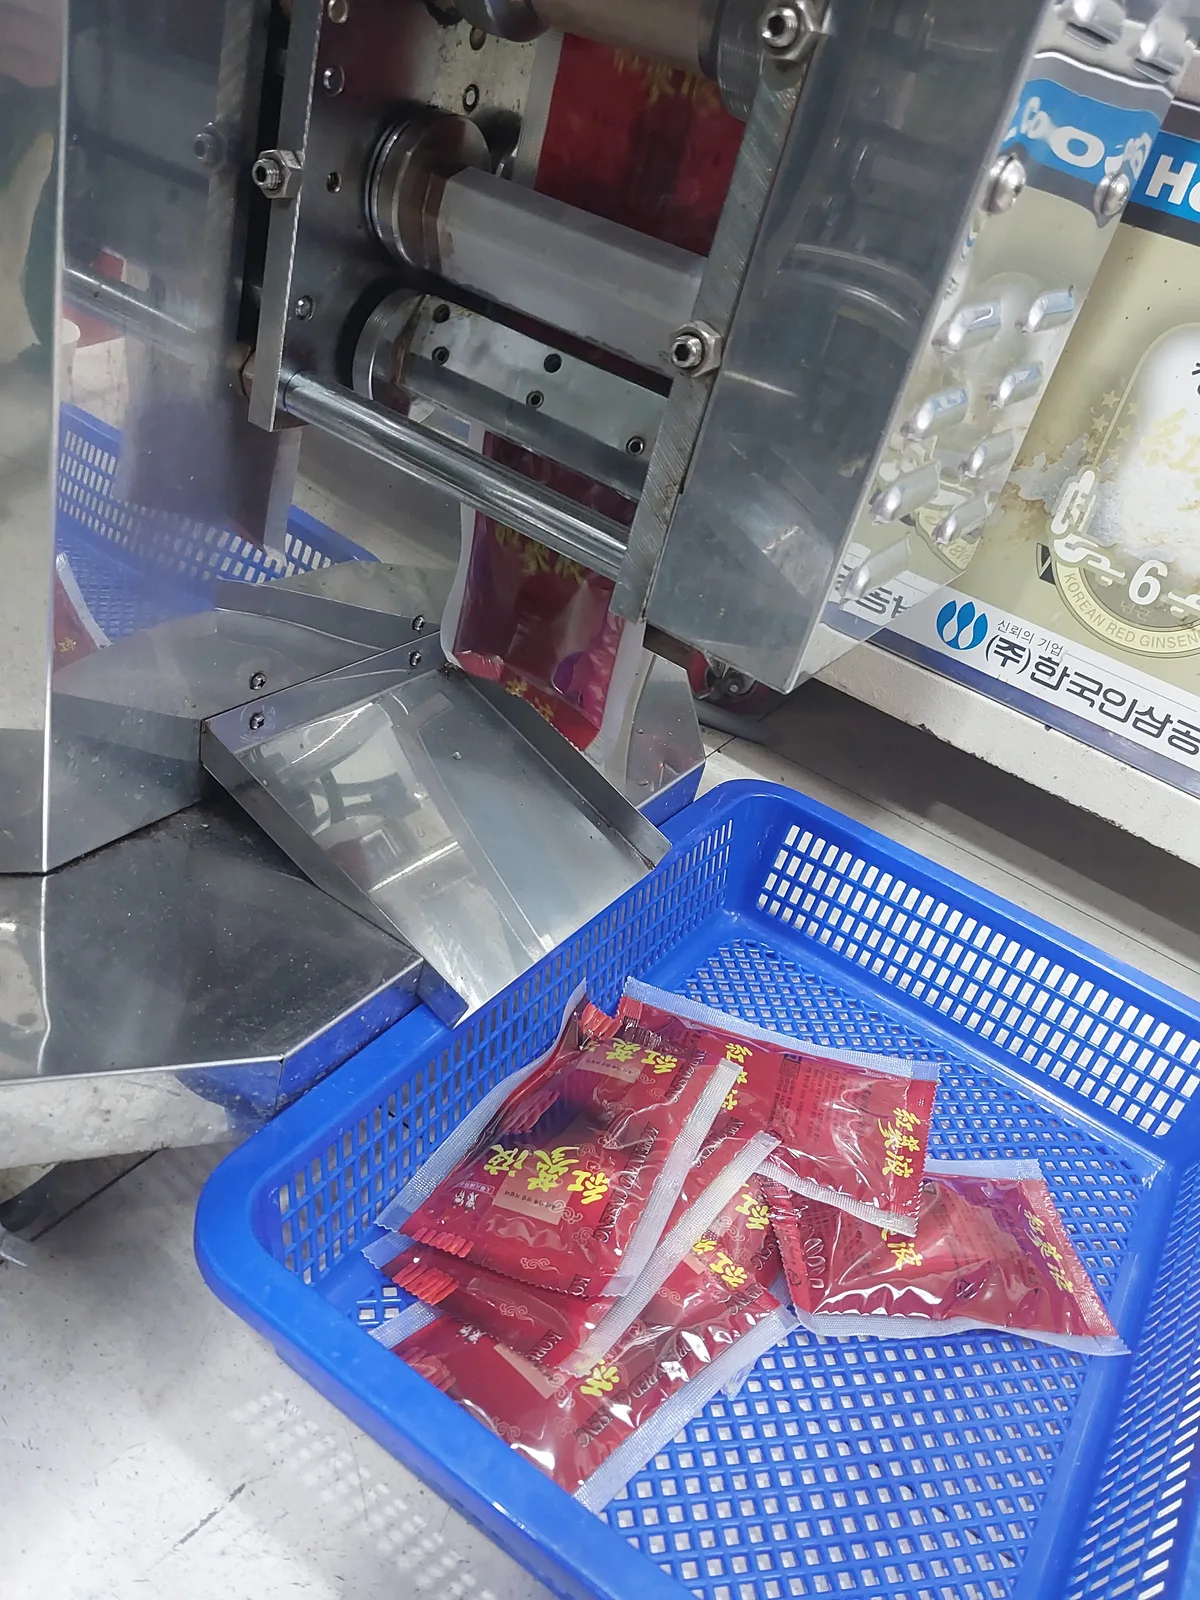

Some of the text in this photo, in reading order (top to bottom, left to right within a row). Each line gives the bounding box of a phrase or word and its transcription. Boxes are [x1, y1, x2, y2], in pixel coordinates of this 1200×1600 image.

[1128, 559, 1168, 606] 6
[1064, 572, 1200, 649] KOREAN RED GINSEN
[997, 619, 1064, 657] 신뢰의 기업
[626, 1368, 660, 1399] RED
